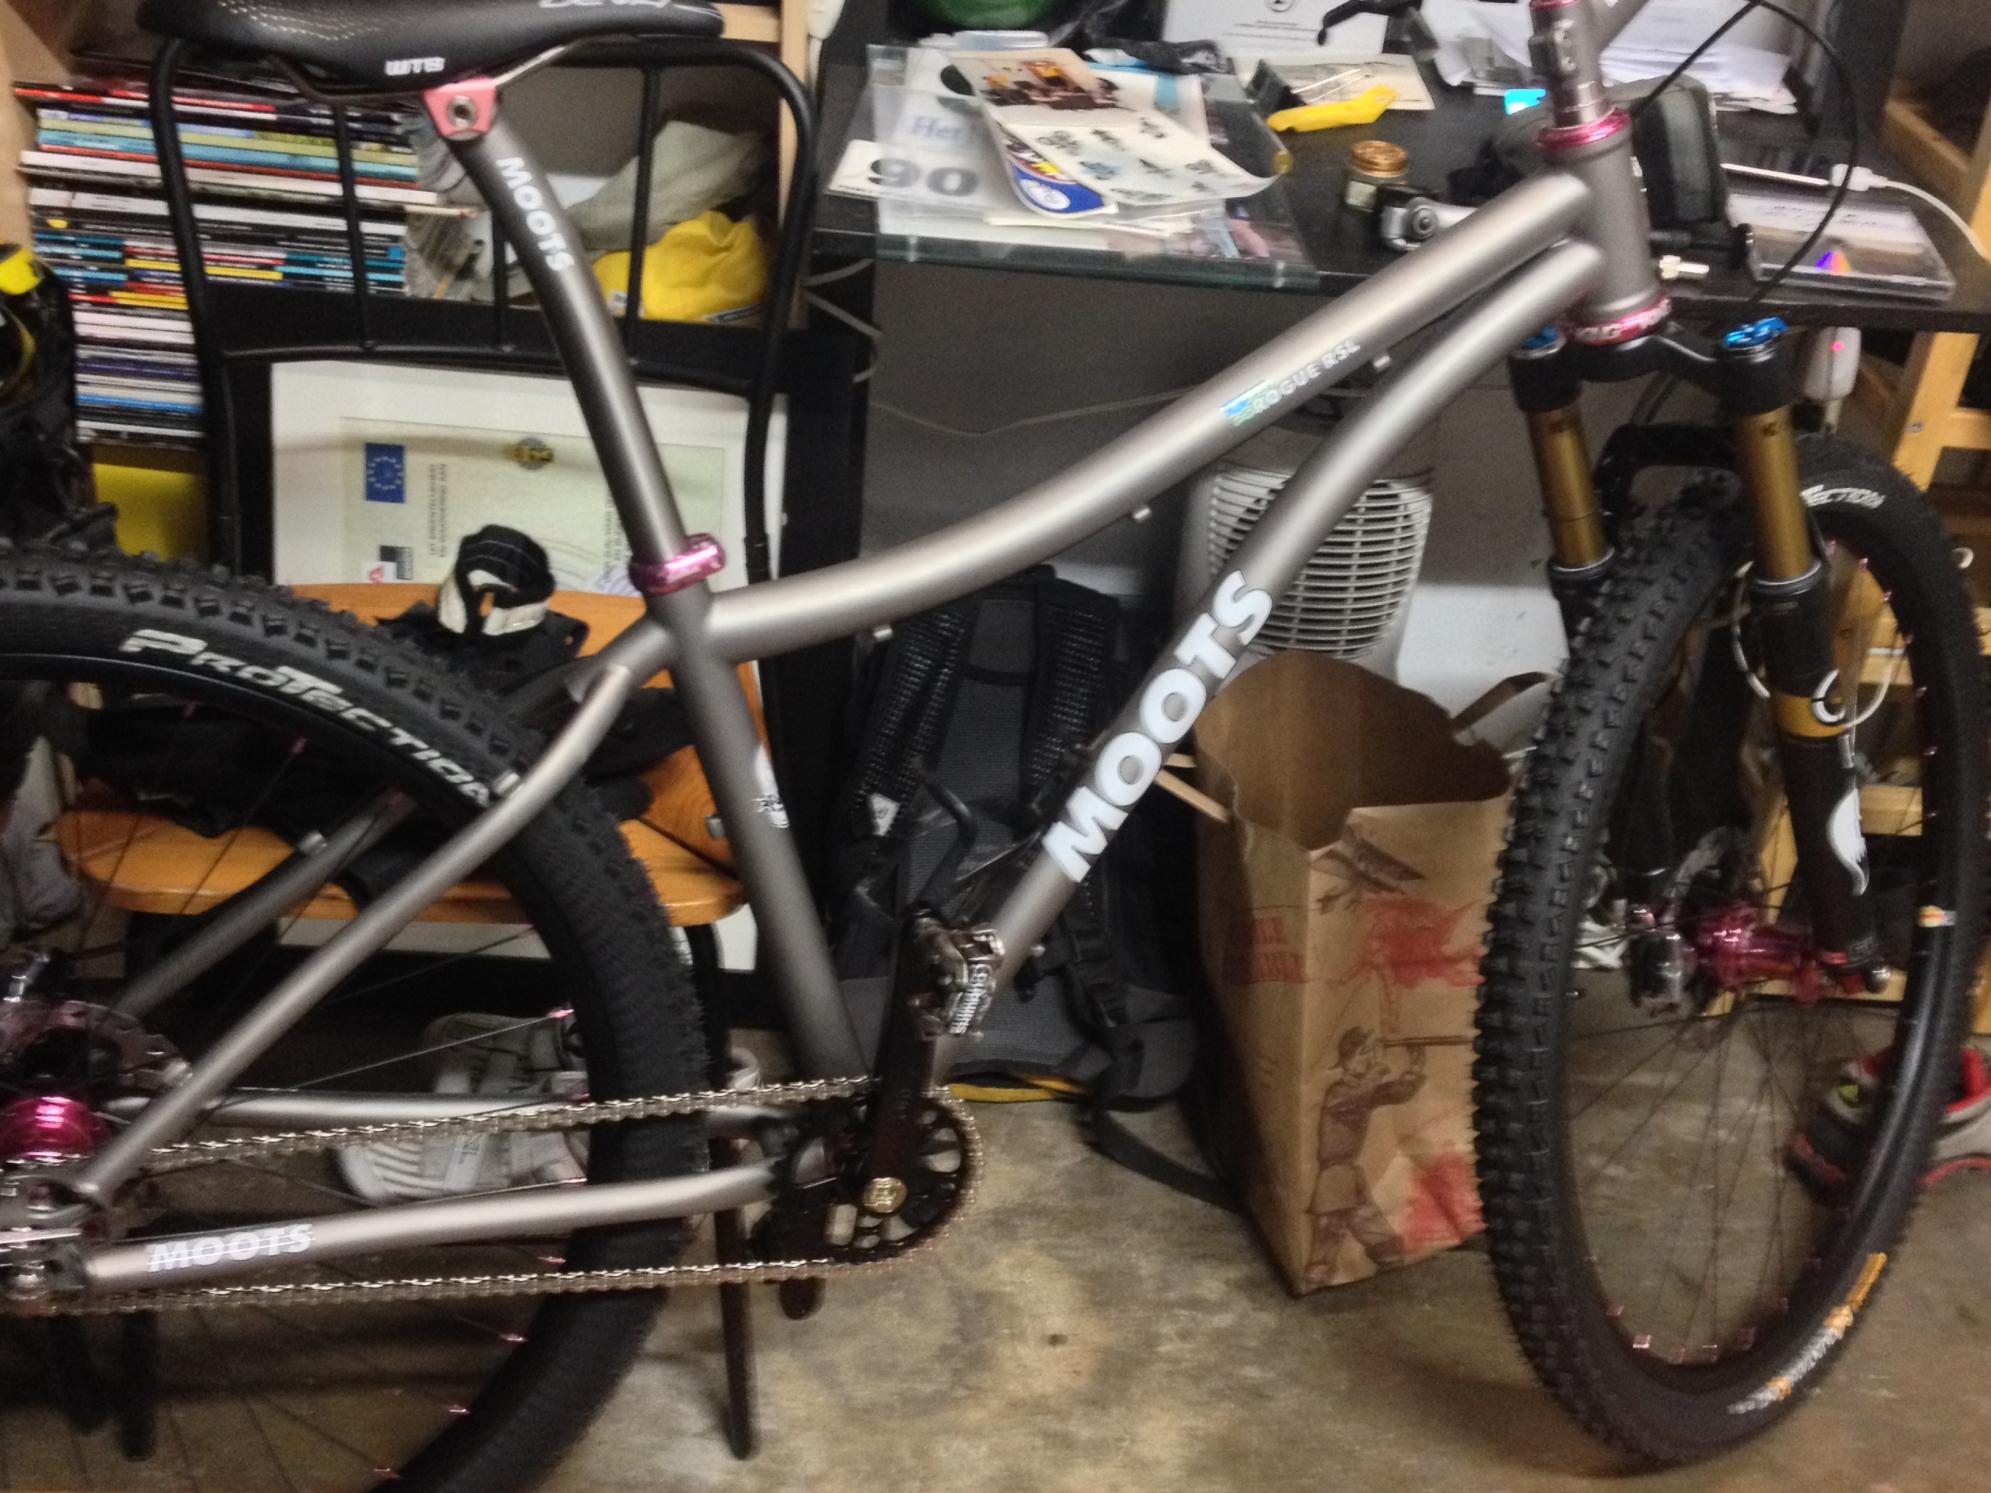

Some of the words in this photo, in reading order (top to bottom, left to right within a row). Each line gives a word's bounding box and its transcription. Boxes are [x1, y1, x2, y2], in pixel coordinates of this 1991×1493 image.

[384, 57, 445, 76] WTB
[868, 158, 980, 197] 90
[496, 157, 575, 271] MOOTS
[1248, 362, 1322, 418] ROGUE
[1042, 570, 1272, 883] MOOTS
[145, 1223, 313, 1272] MOOTS
